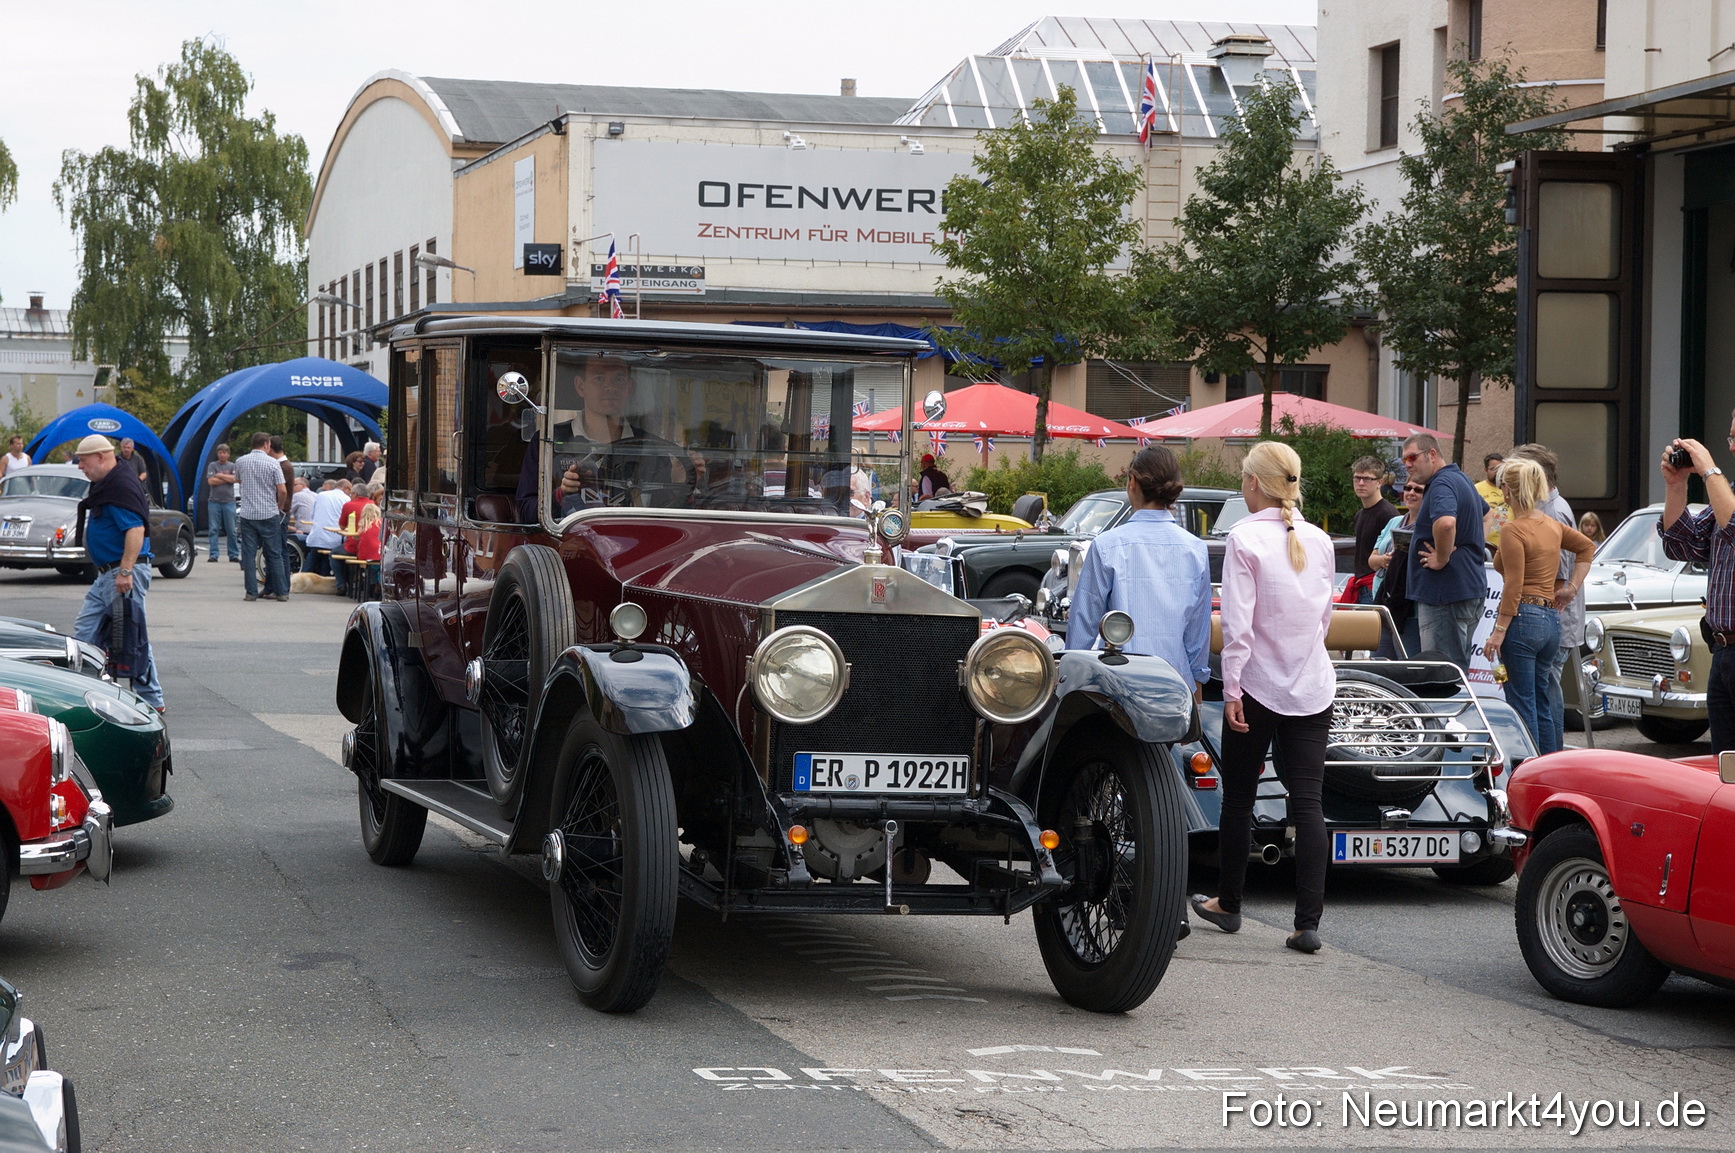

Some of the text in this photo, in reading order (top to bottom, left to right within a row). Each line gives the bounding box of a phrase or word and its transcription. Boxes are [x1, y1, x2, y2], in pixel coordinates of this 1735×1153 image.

[697, 223, 800, 241] ZENTRUM
[808, 224, 849, 243] FÜR
[857, 227, 935, 244] MOBILE
[528, 250, 557, 268] sky
[594, 264, 689, 273] OENWERK
[600, 278, 698, 288] HUPEINGANG
[1468, 671, 1497, 684] arkin
[811, 758, 844, 787] ER
[864, 759, 880, 788] P
[887, 760, 968, 790] 1922H
[1352, 837, 1370, 857] RI
[1386, 837, 1422, 857] 537
[1426, 837, 1450, 857] DC
[692, 1066, 1449, 1082] OFENWERK
